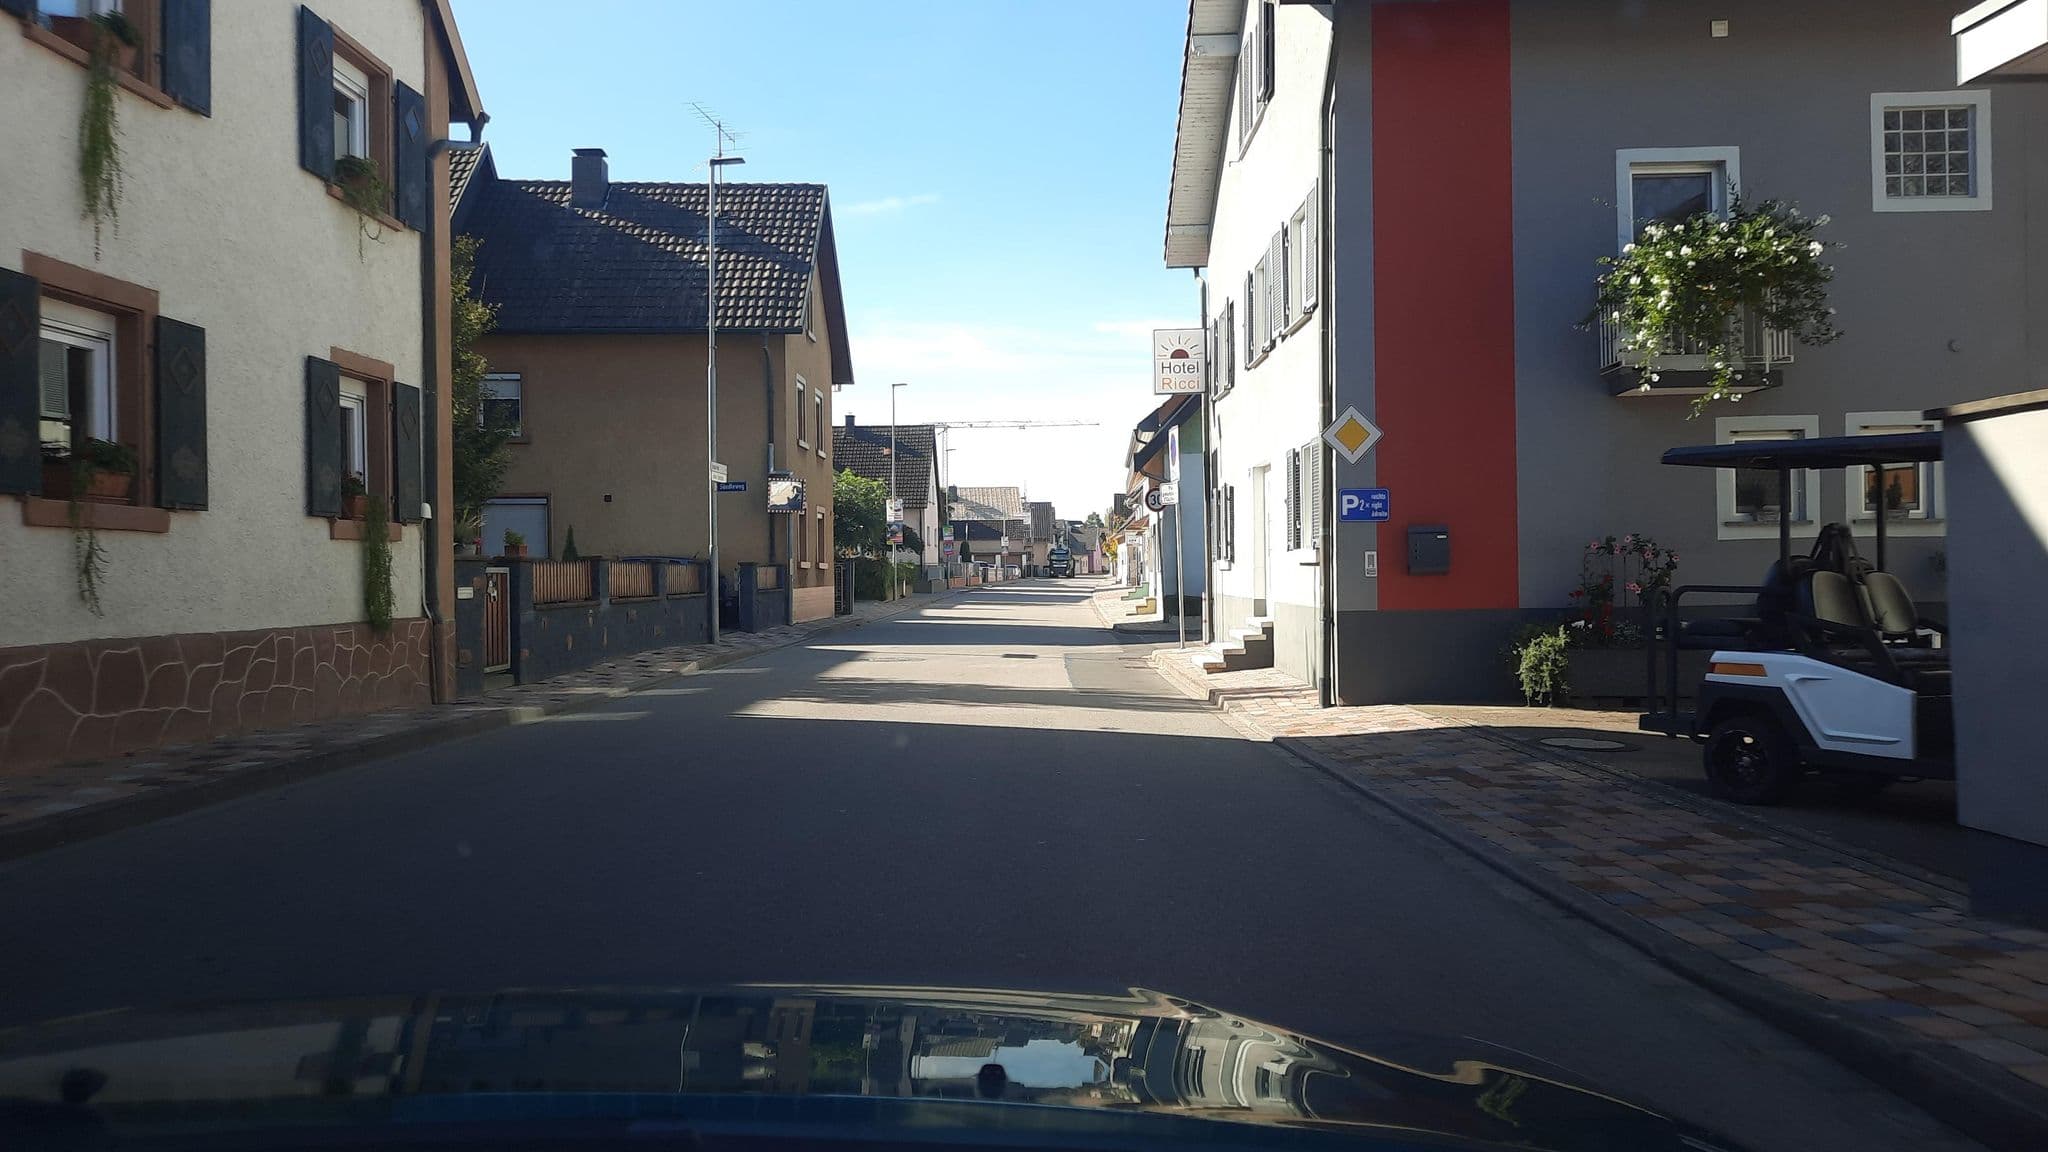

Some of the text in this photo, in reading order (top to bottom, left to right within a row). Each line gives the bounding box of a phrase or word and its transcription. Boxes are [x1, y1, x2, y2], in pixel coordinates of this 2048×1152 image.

[1161, 361, 1199, 374] Hotel
[1161, 377, 1200, 390] Ricci
[1342, 495, 1359, 515] P
